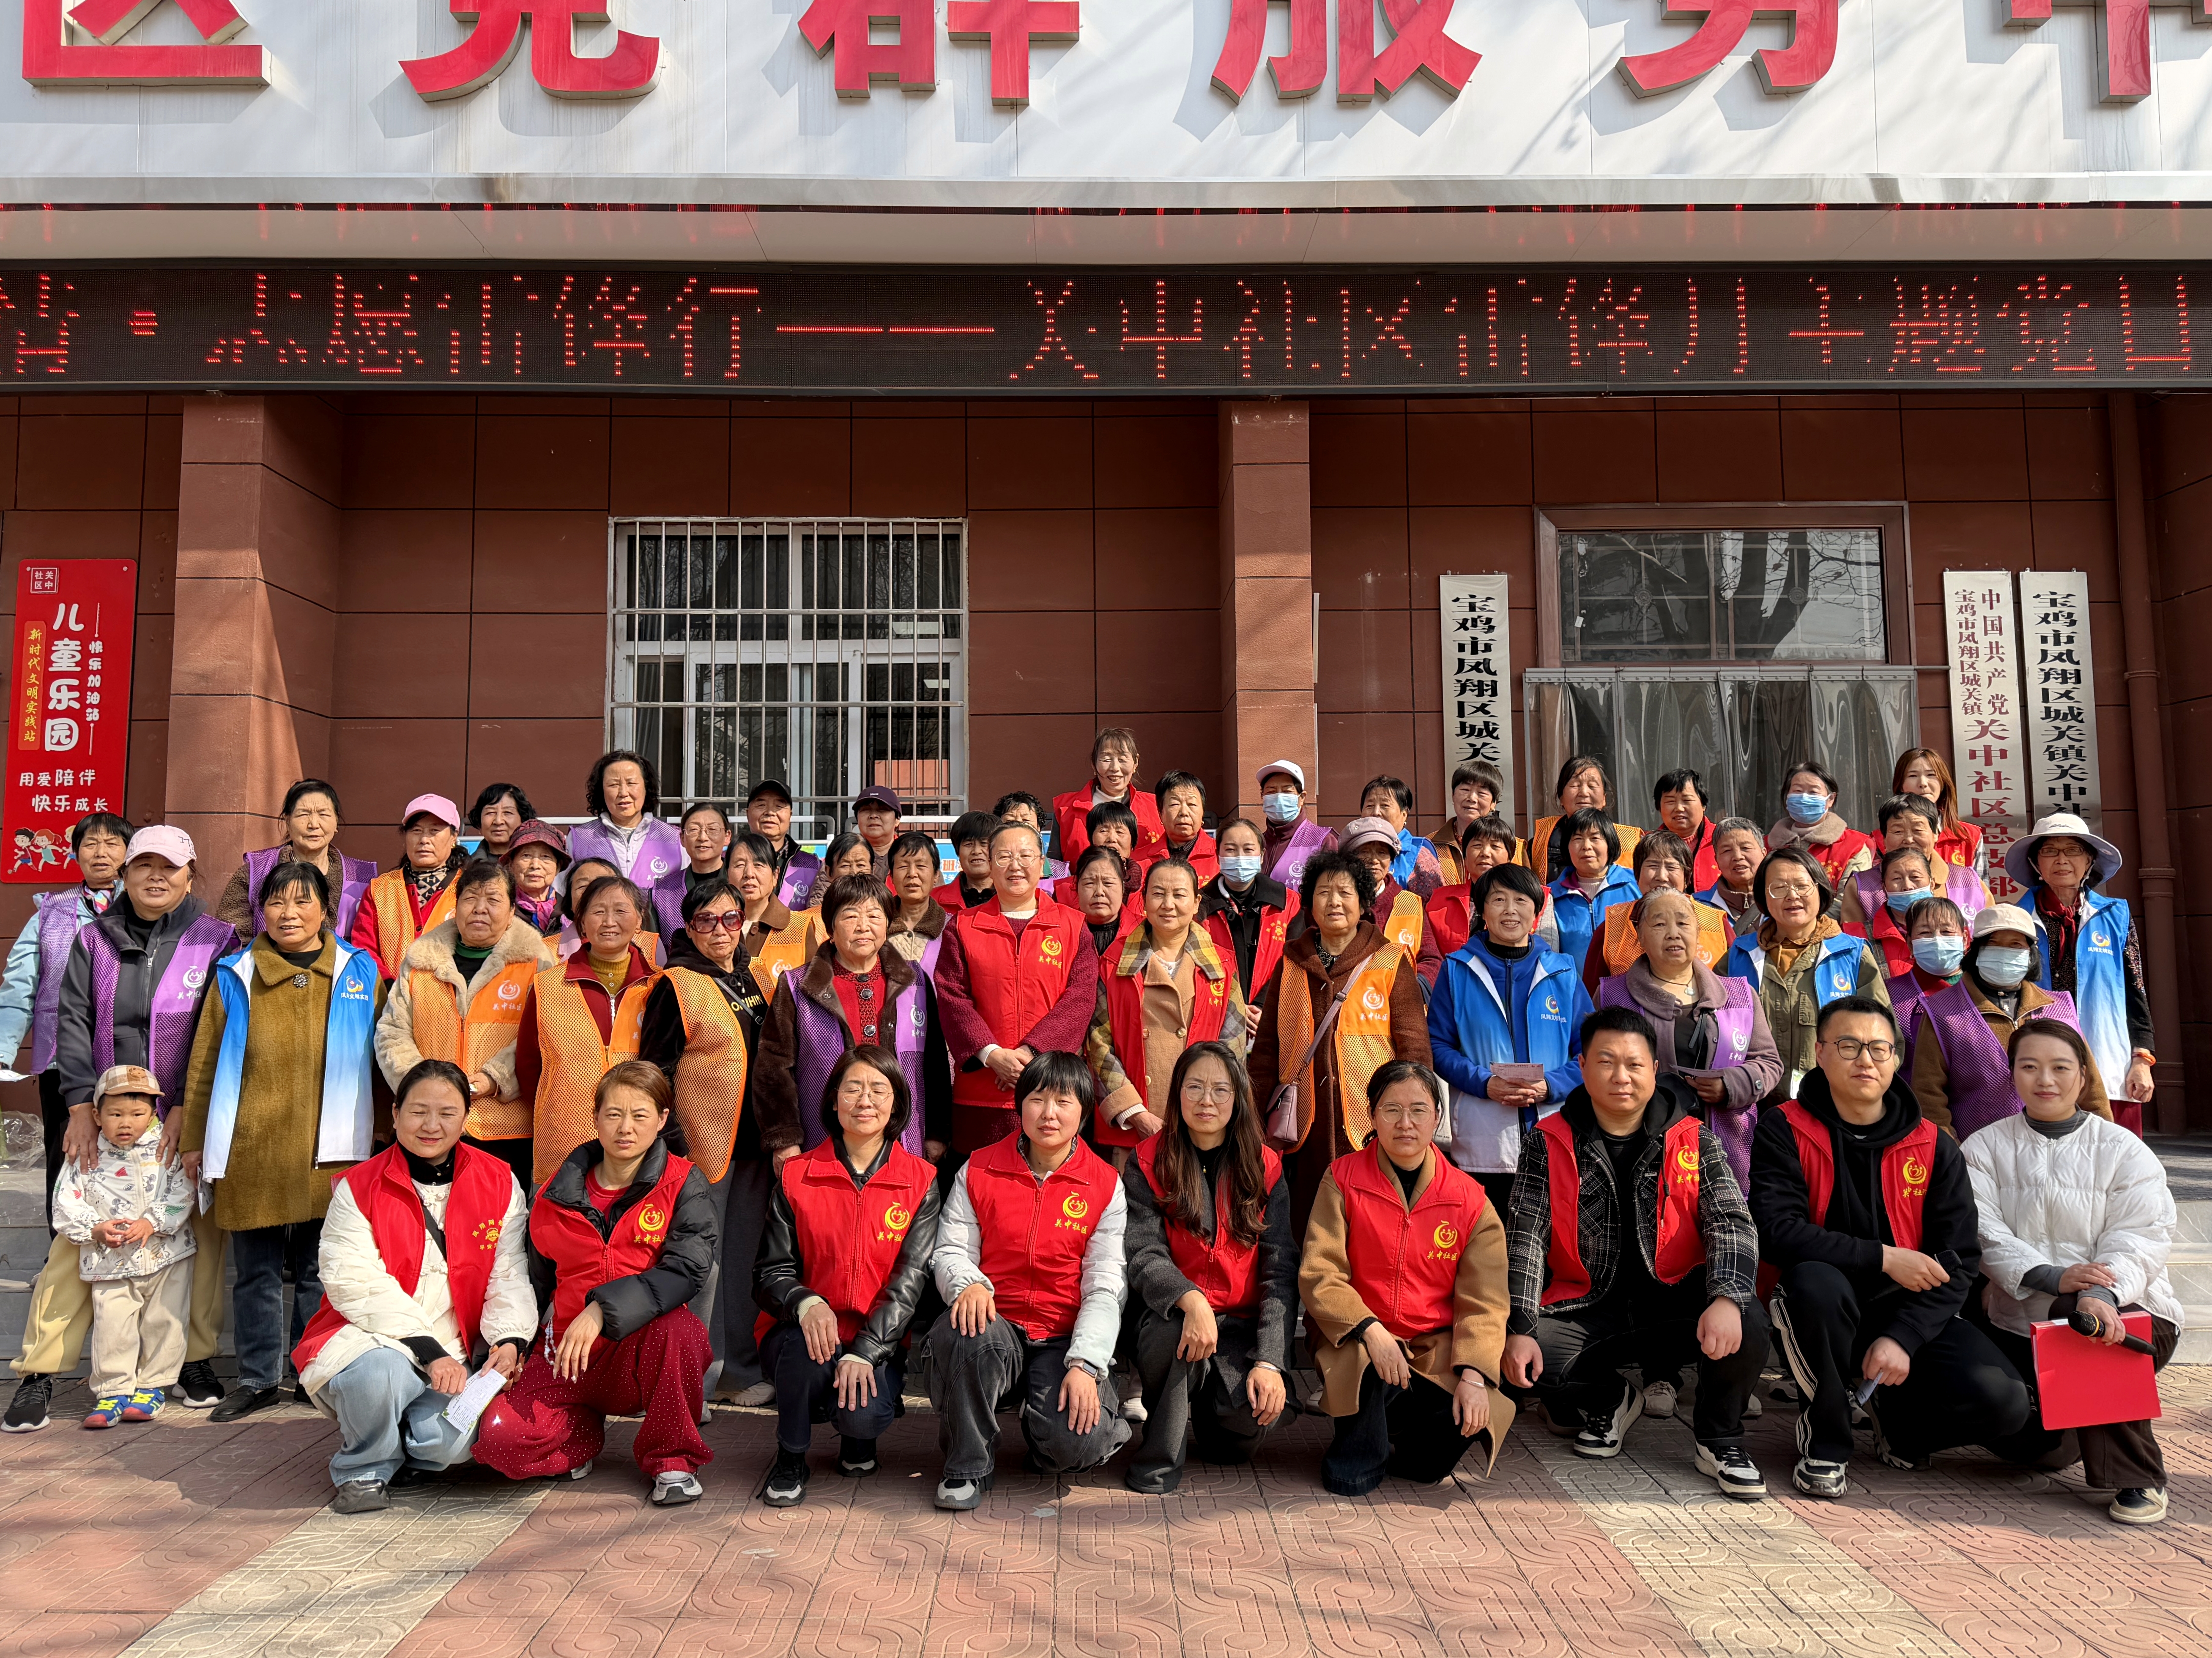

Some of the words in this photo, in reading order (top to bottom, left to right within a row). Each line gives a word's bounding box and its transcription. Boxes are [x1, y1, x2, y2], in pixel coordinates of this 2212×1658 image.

[44, 602, 85, 752] 儿童乐园
[1954, 589, 1984, 717] 宝鸡市凤翔区城关镇
[1981, 588, 2010, 716] 中国共产党
[24, 628, 42, 742] 新时代文明实践站
[86, 640, 103, 722] 快乐加油站
[1451, 594, 1502, 767] 宝鸡市凤翔区城关
[19, 769, 96, 787] 用爱陪伴
[31, 794, 109, 813] 快乐成长
[1963, 719, 2019, 897] 关中社区总支部
[1038, 955, 1062, 969] 关中社区
[493, 1002, 522, 1011] 关中社区
[1360, 1012, 1388, 1021] 关中社区
[1054, 1218, 1088, 1234] 关中社区
[1427, 1250, 1458, 1261] 关中社区
